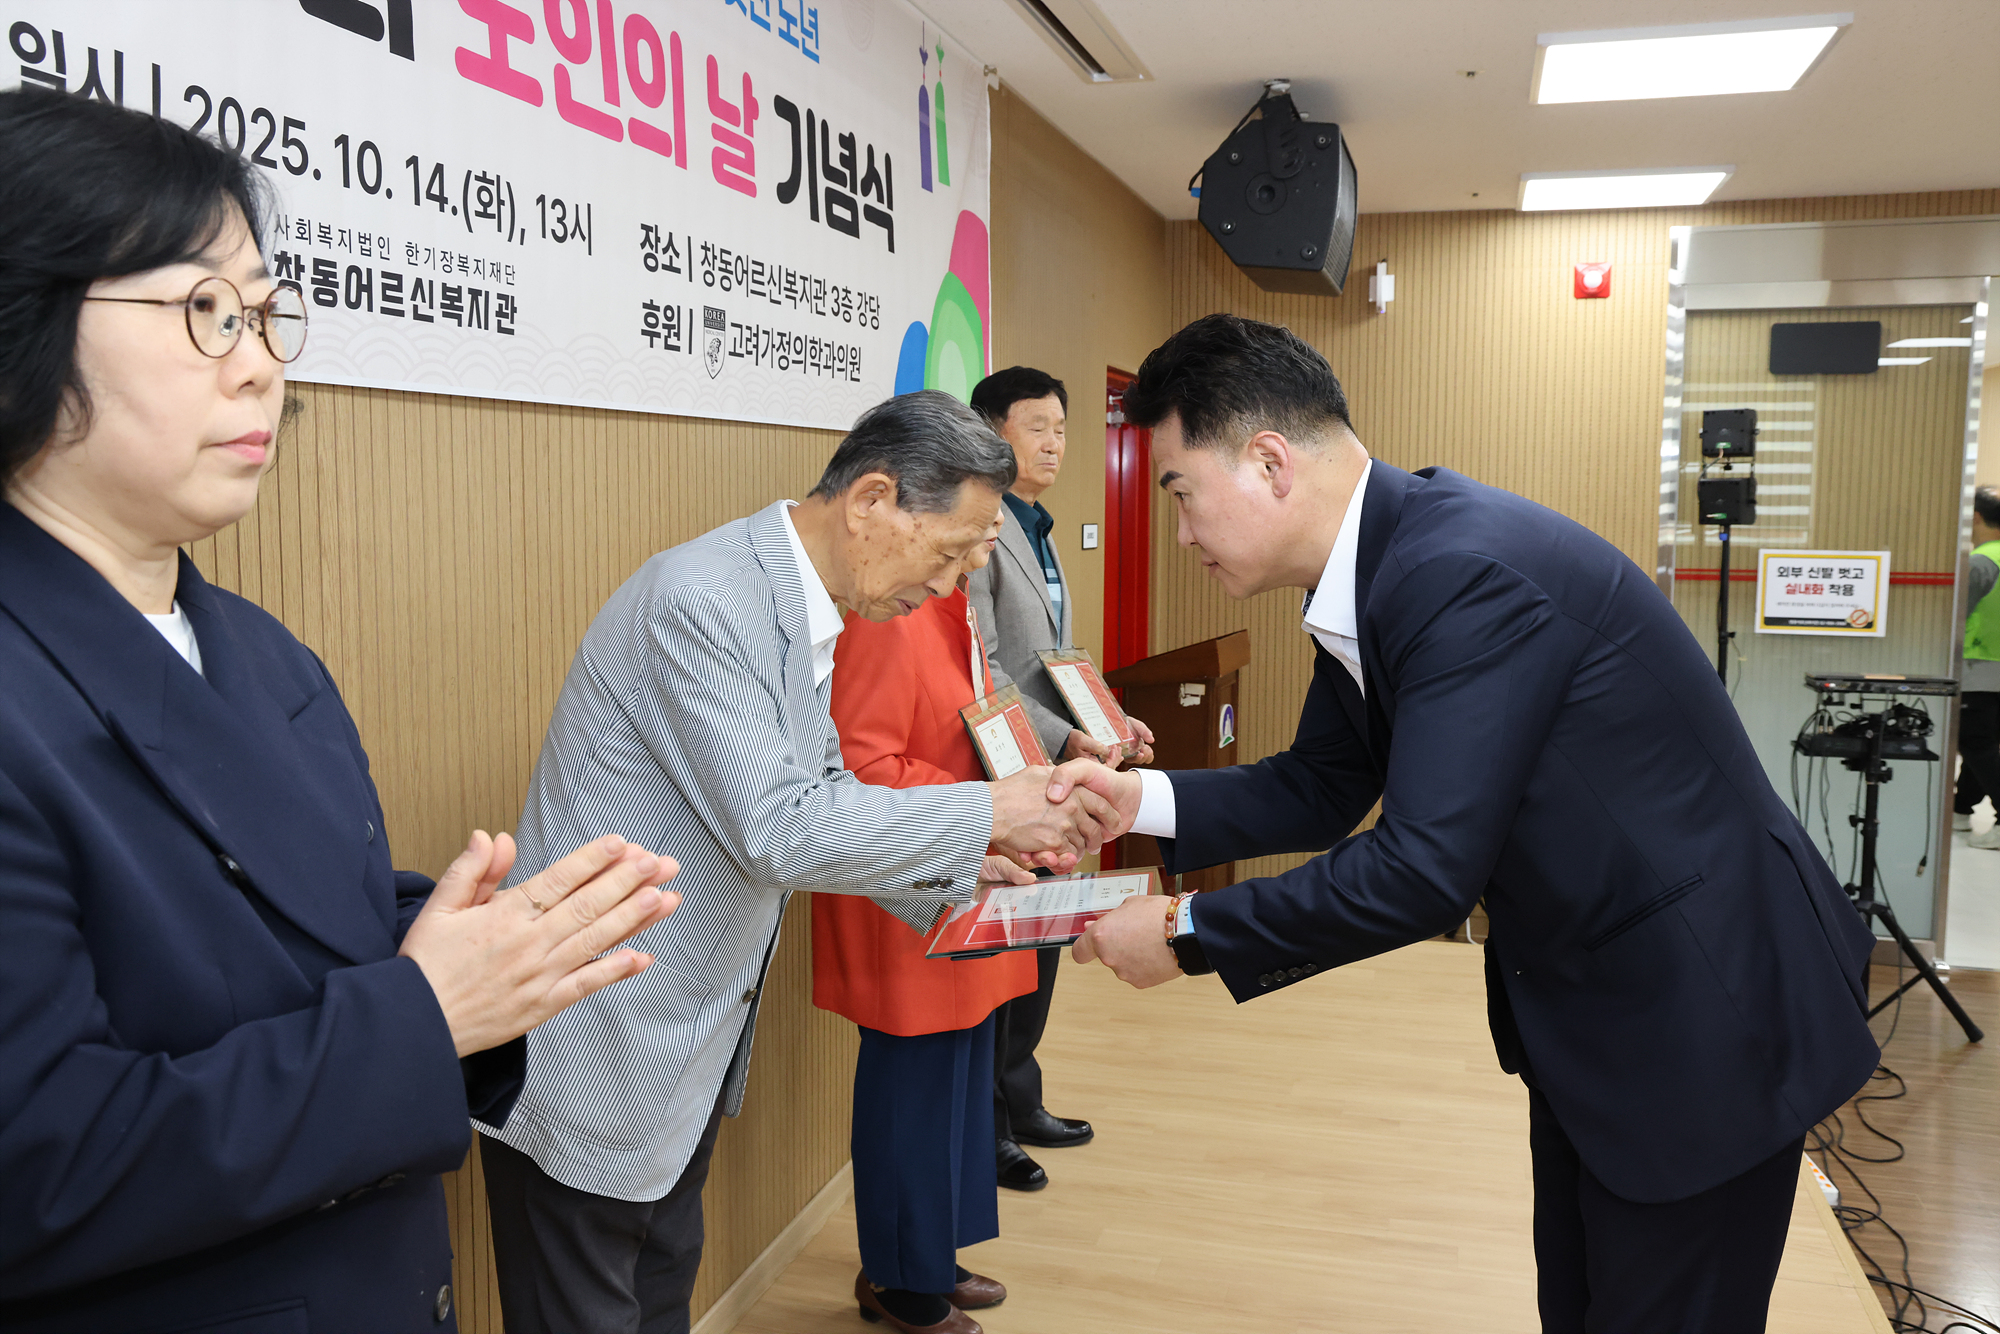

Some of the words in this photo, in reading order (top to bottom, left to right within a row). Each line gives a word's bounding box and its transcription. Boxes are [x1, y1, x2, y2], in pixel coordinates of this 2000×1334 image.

[455, 0, 687, 170] 노인의
[706, 54, 760, 198] 날
[773, 94, 895, 254] 기념식
[183, 84, 322, 181] 2025.
[333, 133, 394, 200] 10.
[535, 193, 593, 256] 13시
[274, 213, 391, 261] 사회복지법인
[404, 240, 516, 286] 한기장복지재단
[639, 222, 682, 275] 장소
[273, 249, 518, 336] 창동어르신복지관
[700, 240, 828, 316] 창동어르신복지관
[830, 285, 854, 323] 3층
[857, 291, 881, 331] 강당
[704, 308, 725, 322] KOREA
[640, 298, 681, 352] 후원
[728, 321, 862, 383] 고려가정의학과의원
[1777, 565, 1803, 578] 외부
[1808, 566, 1834, 579] 신발
[1838, 567, 1865, 580] 벗고
[1785, 583, 1824, 595] 실내화
[1829, 584, 1855, 597] 착용
